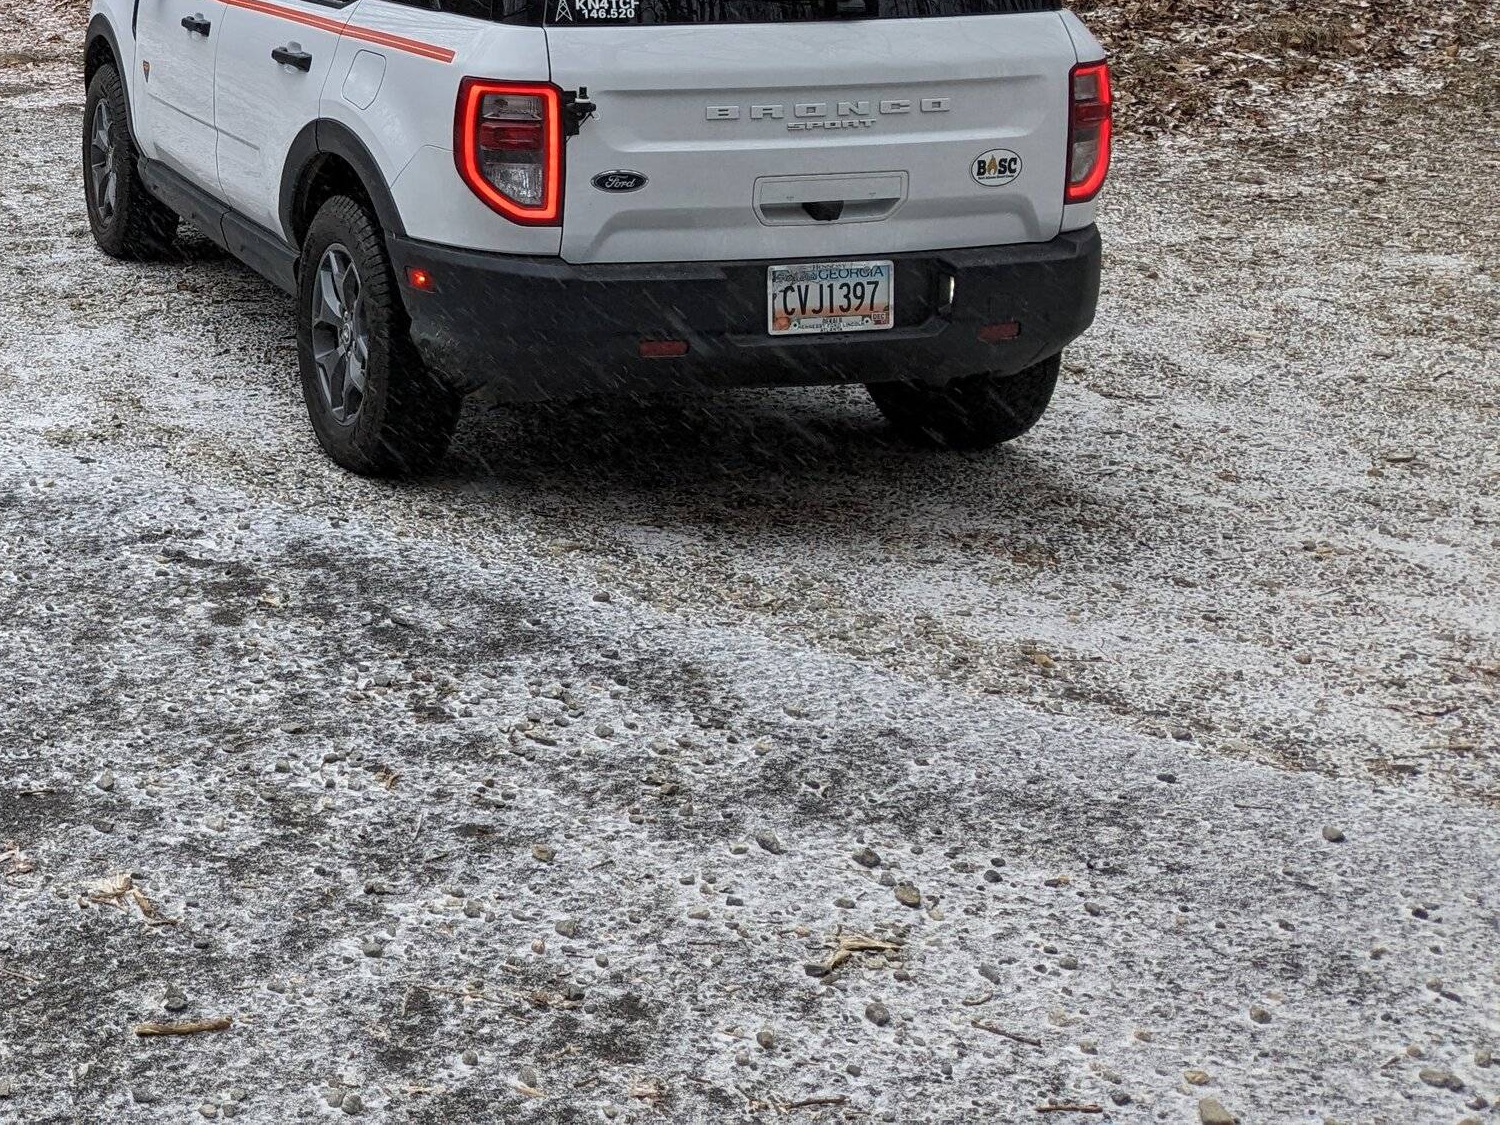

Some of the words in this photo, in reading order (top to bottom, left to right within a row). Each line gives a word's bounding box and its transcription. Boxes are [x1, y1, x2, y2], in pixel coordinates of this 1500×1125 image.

[582, 8, 635, 19] 146.520
[706, 97, 951, 121] BRONCO
[786, 118, 877, 131] SPORT
[605, 175, 636, 188] Ford
[819, 266, 884, 281] GEORGIA
[783, 280, 879, 316] CVJ1397
